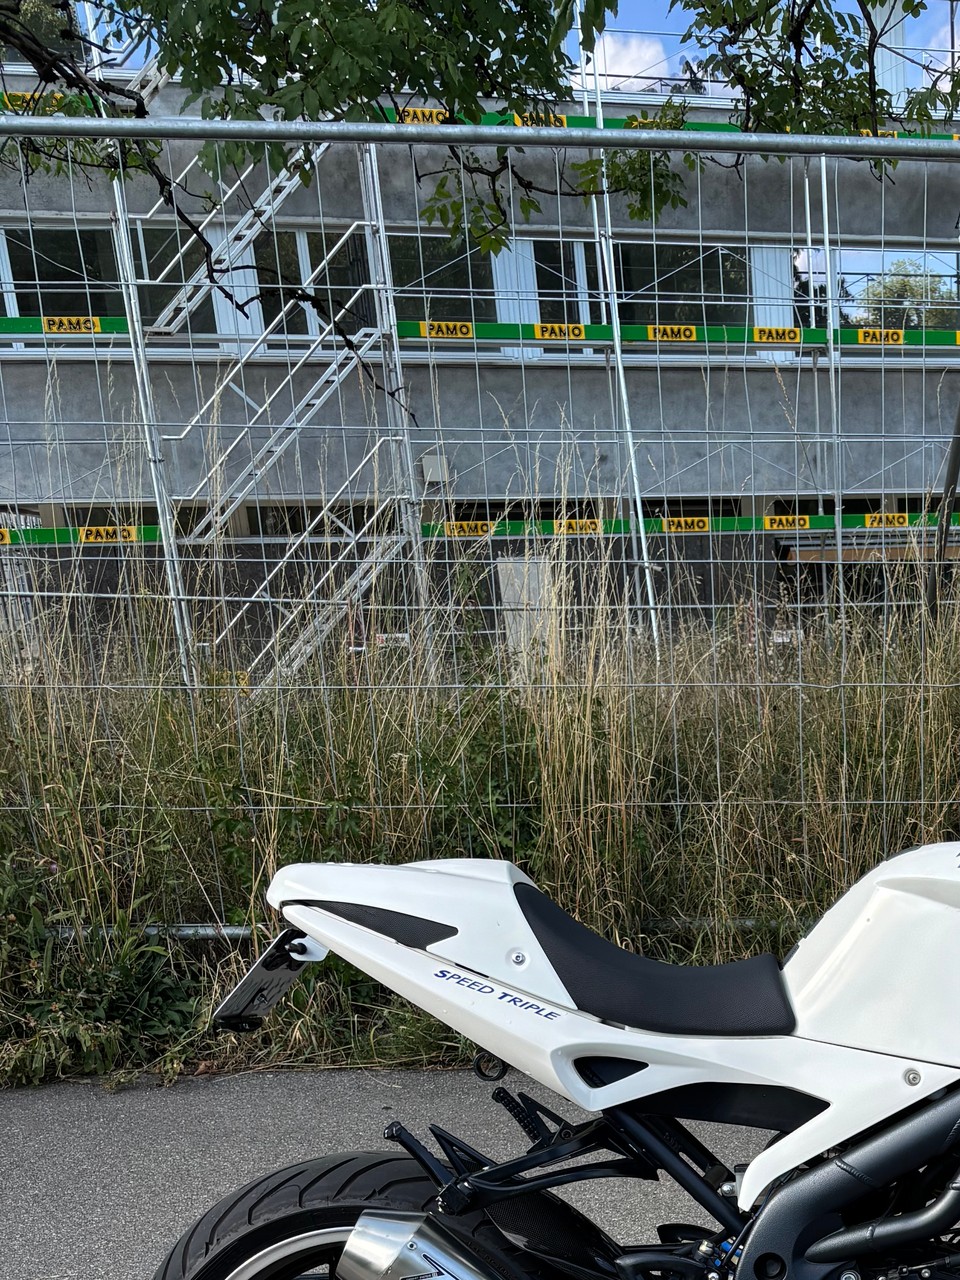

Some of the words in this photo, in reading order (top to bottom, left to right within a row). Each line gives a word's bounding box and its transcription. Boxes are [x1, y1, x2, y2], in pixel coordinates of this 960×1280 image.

[403, 110, 447, 124] PAMO
[47, 318, 95, 331] PAMO
[429, 324, 470, 336] PAMO
[541, 325, 582, 338] PAMO
[653, 327, 693, 339] PAMO
[758, 329, 797, 341] PAMO
[863, 331, 900, 342] PAMO
[667, 518, 707, 530] PAMO
[769, 517, 807, 528] PAMO
[869, 515, 907, 526] PAMO
[85, 528, 131, 541] PAMO
[434, 969, 495, 994] SPEED
[497, 991, 561, 1020] TRIPLE
